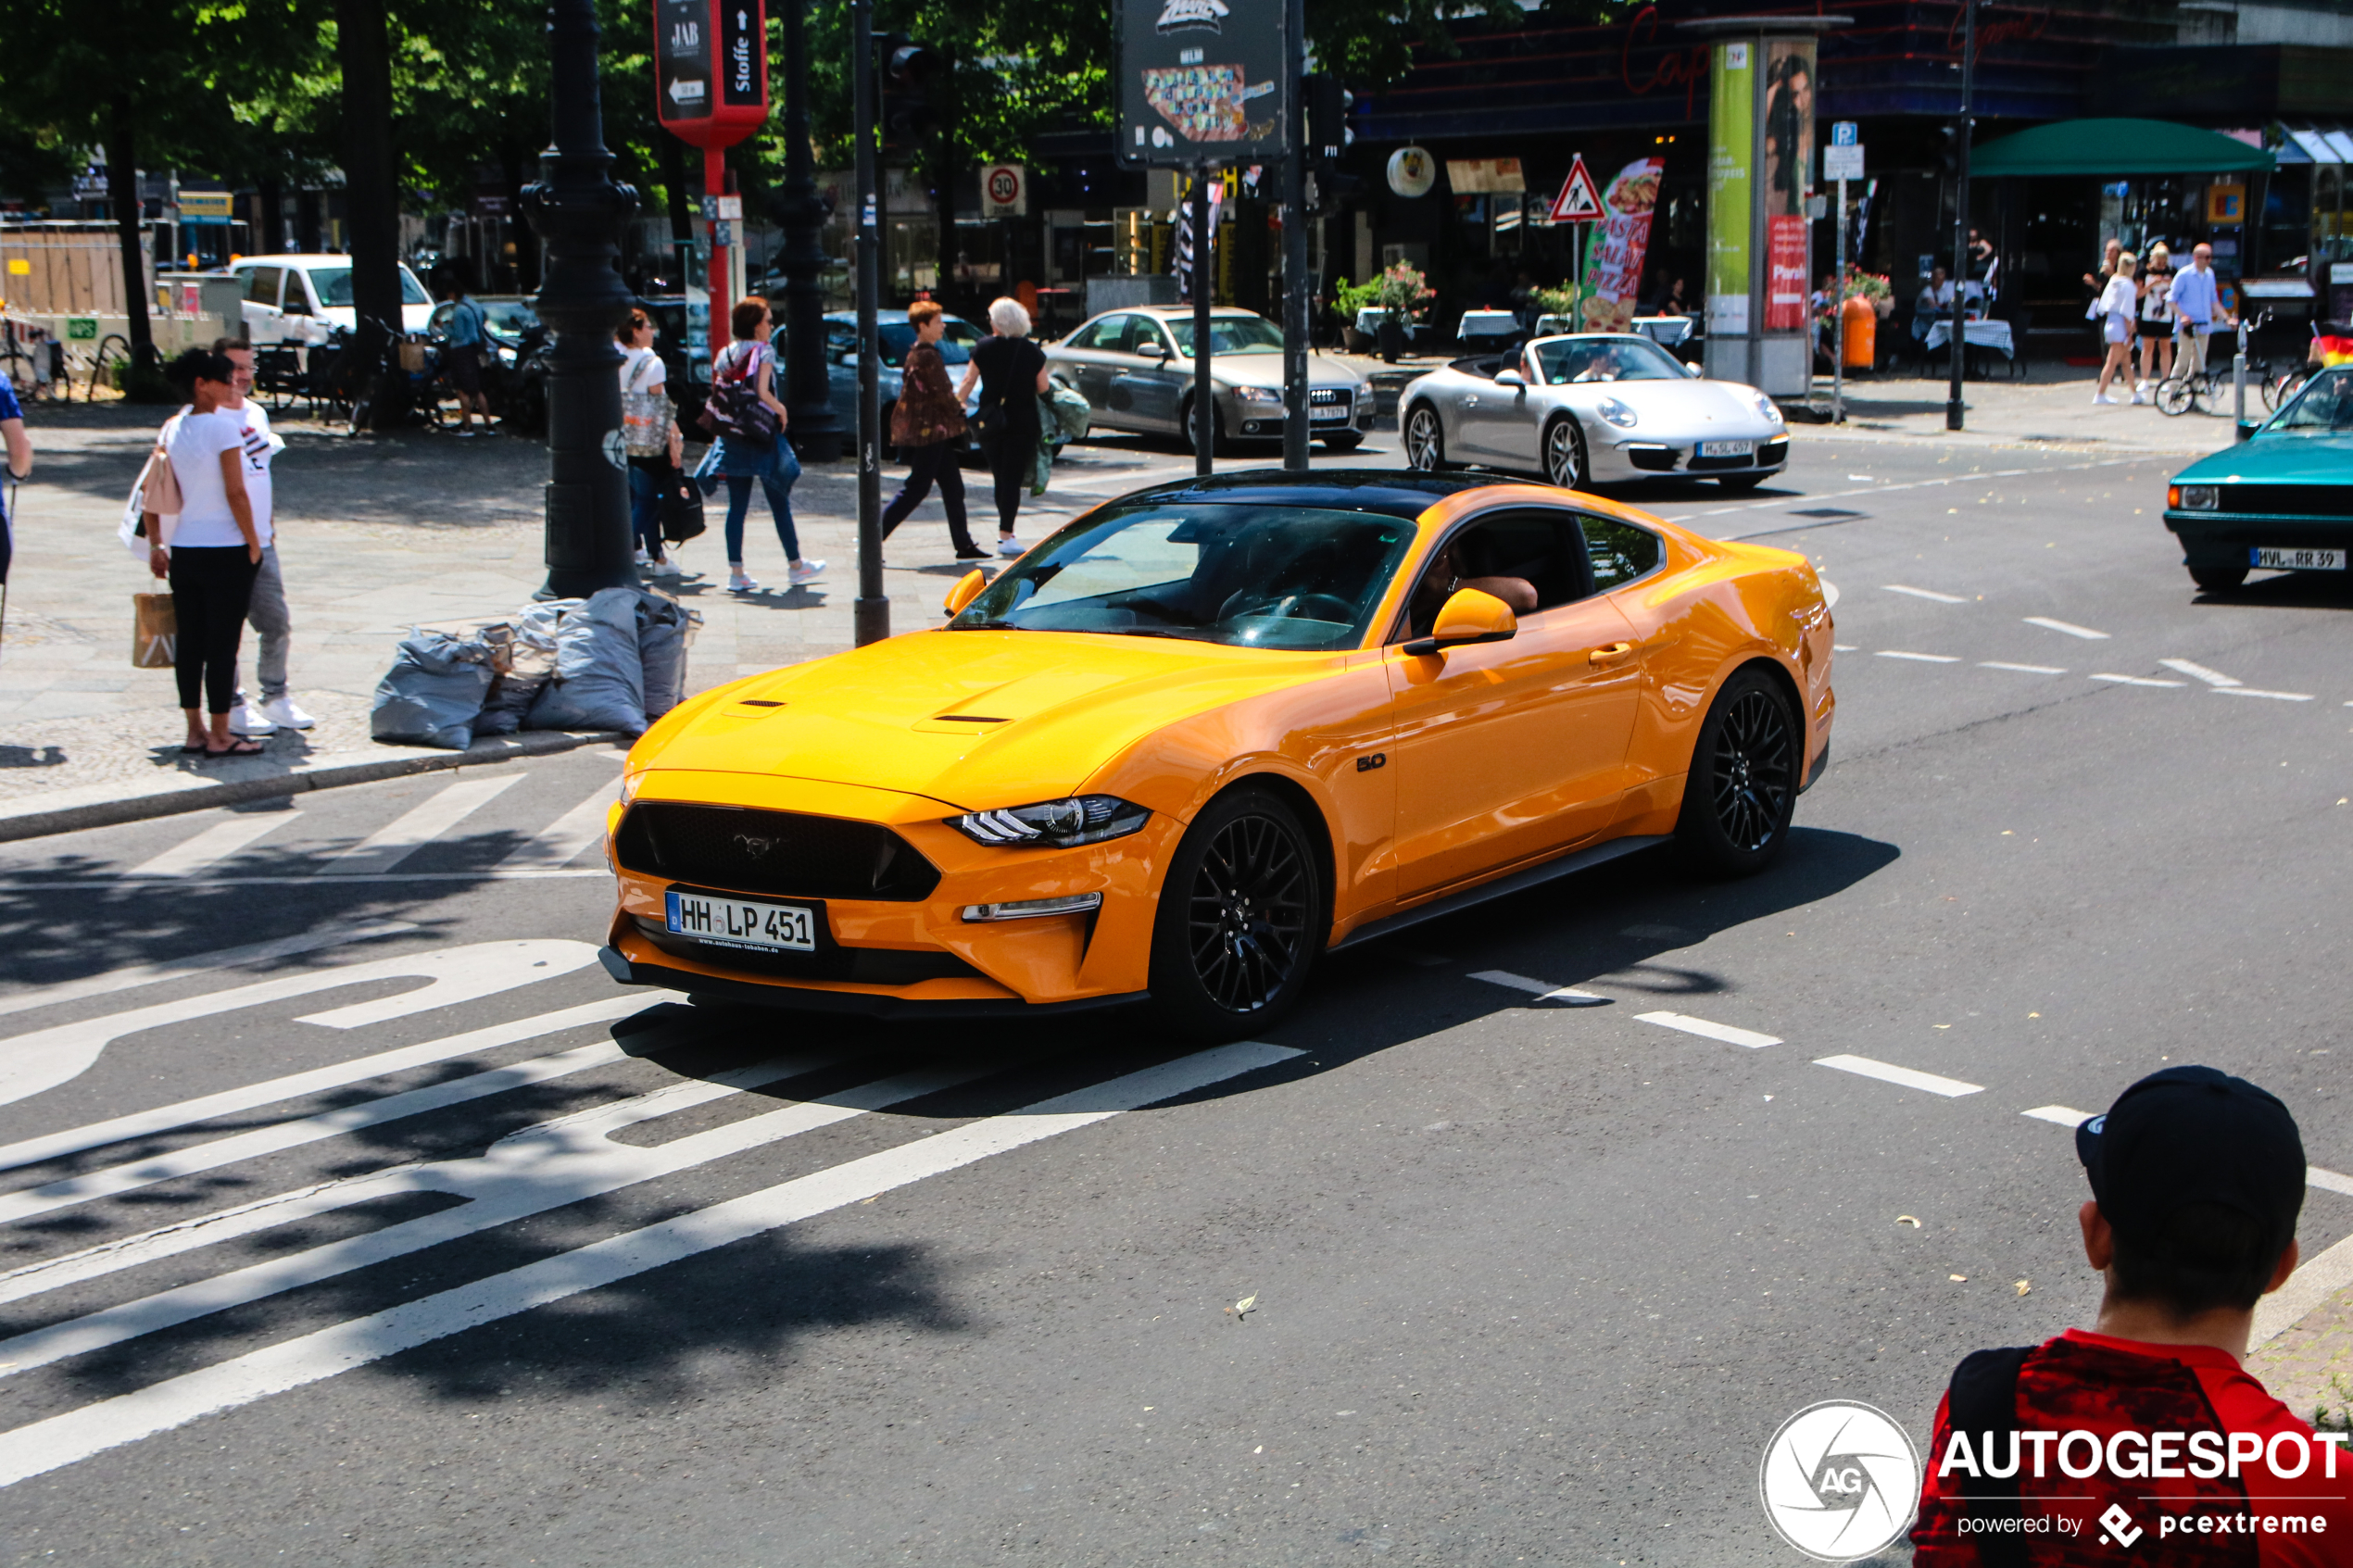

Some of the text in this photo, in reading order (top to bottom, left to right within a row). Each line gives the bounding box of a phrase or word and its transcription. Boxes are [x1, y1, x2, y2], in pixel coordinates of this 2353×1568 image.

[672, 21, 699, 46] JAB
[733, 37, 750, 92] Stoffe
[995, 177, 1012, 194] 30
[1593, 217, 1649, 244] PASTA
[1590, 241, 1645, 269] SALAT
[1585, 267, 1639, 297] PIZZA
[2259, 551, 2334, 568] HVL RR 39
[672, 916, 678, 925] D
[681, 899, 811, 944] HH LP 451
[698, 937, 779, 953] www.autohaus-tobaben.de
